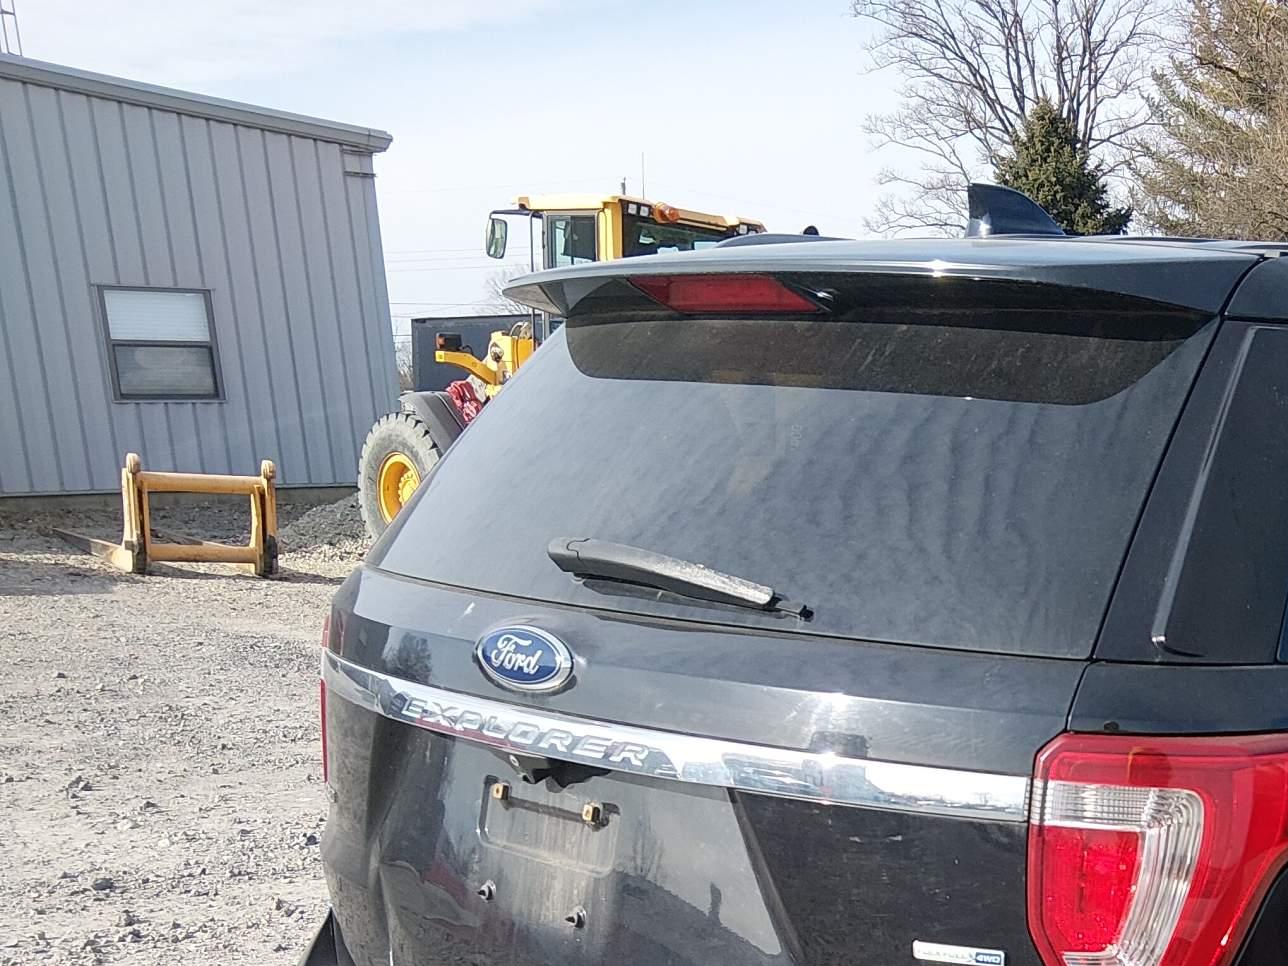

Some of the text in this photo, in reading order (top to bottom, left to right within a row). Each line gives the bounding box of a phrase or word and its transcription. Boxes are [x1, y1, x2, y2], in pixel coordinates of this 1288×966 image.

[491, 634, 543, 675] Ford
[402, 698, 651, 767] EXPLORER
[976, 954, 1002, 965] 4WD
